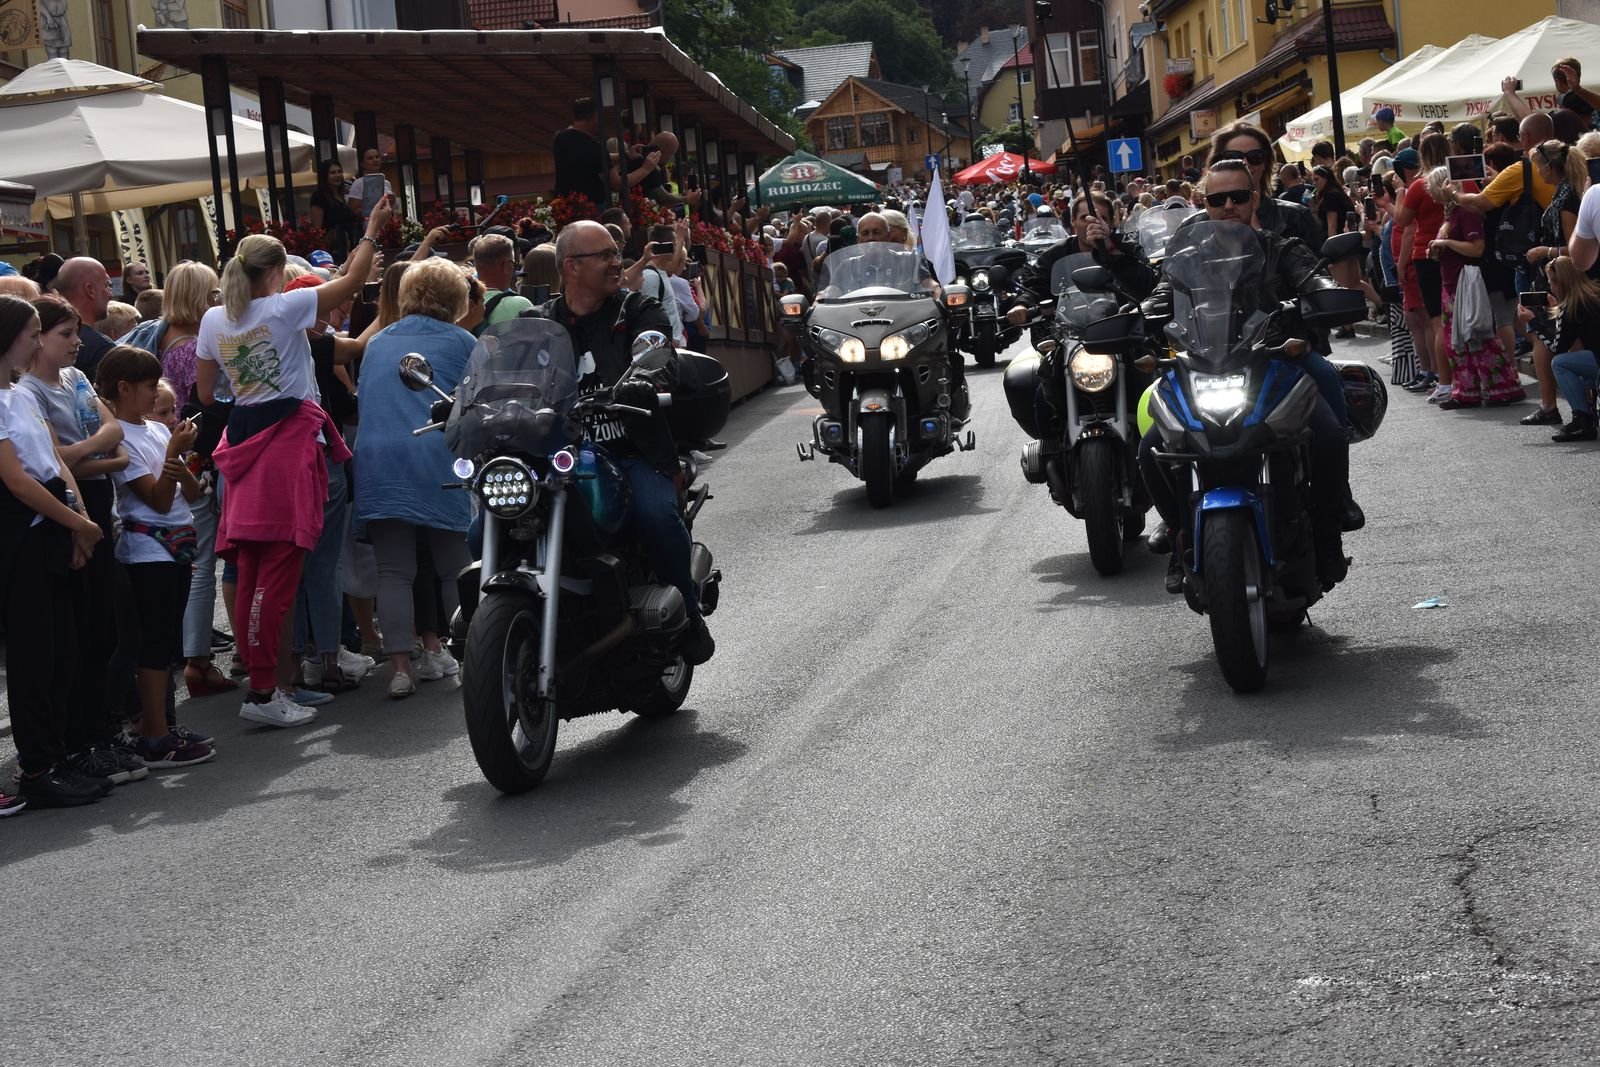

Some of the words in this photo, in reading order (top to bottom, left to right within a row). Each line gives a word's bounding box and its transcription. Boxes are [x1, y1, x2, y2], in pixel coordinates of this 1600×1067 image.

[1417, 104, 1449, 119] VERDE
[1465, 100, 1492, 116] TYSKIE
[768, 181, 842, 196] ROHOZEC
[216, 325, 273, 345] SUMMER
[264, 348, 280, 370] 3
